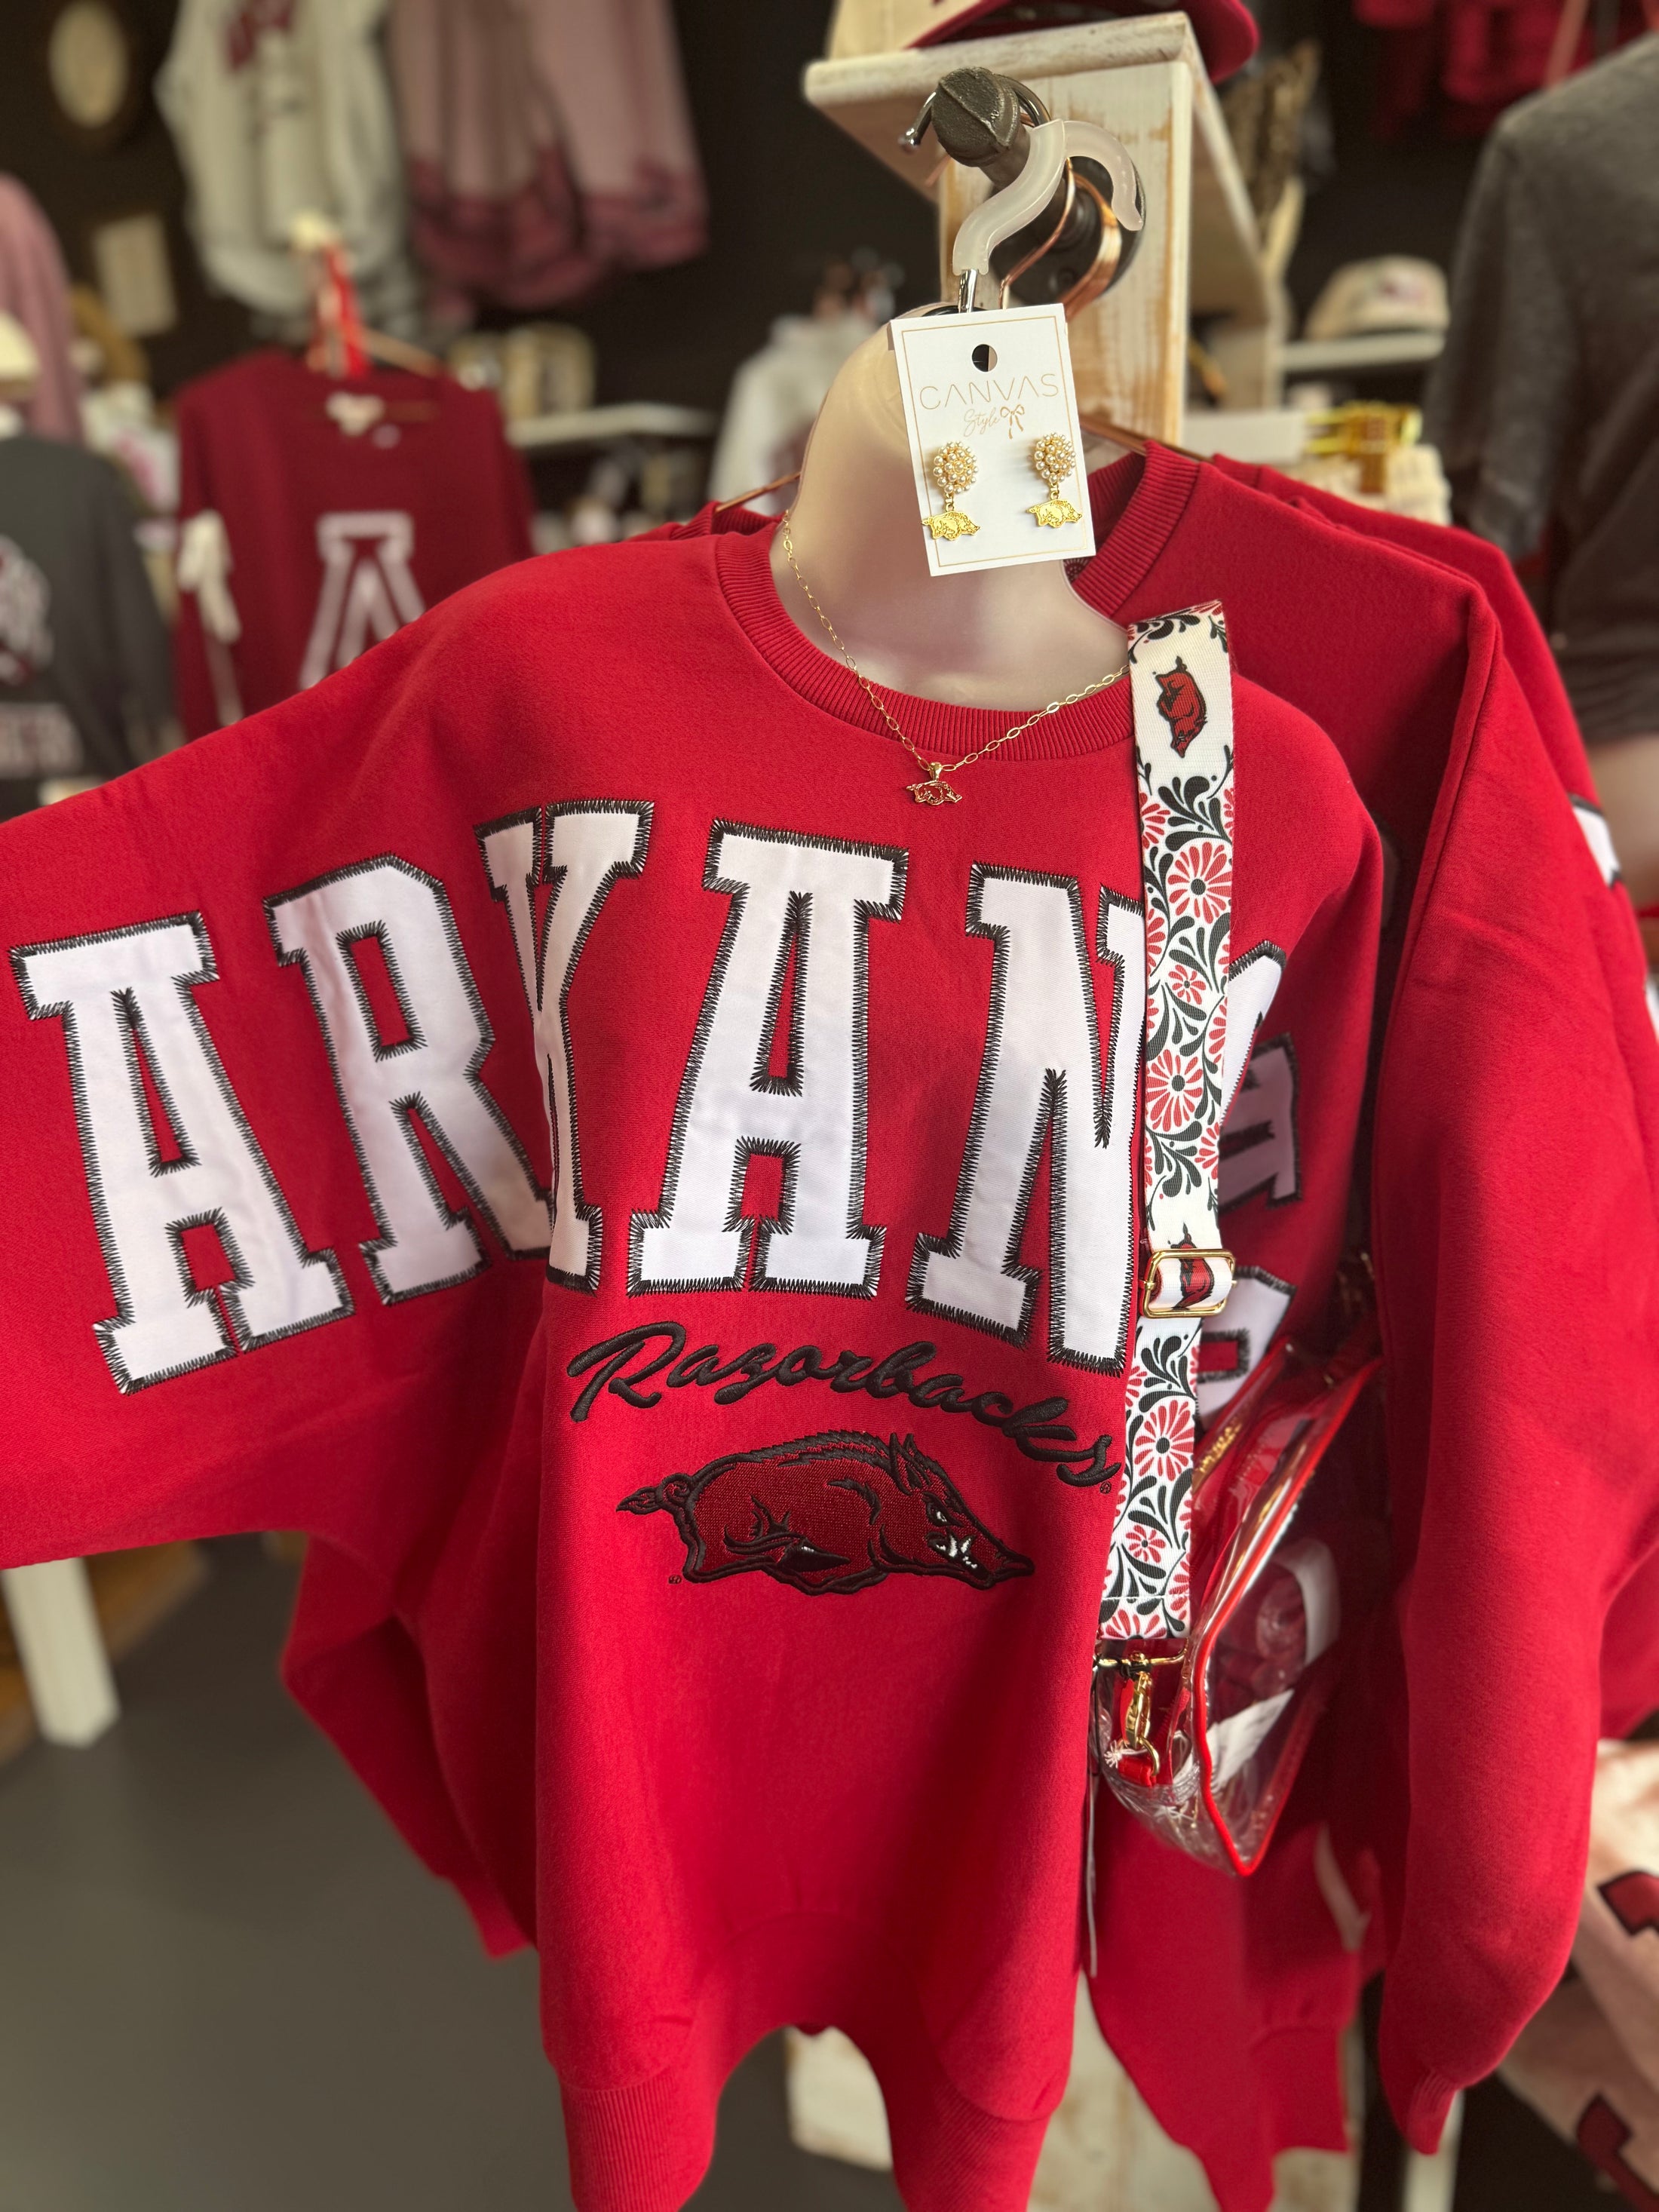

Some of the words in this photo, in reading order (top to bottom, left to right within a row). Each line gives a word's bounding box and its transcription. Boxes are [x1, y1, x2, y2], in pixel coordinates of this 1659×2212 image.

[919, 373, 1059, 410] CANVAS
[963, 407, 1001, 437] Style
[566, 1321, 1122, 1488] Razorbacks
